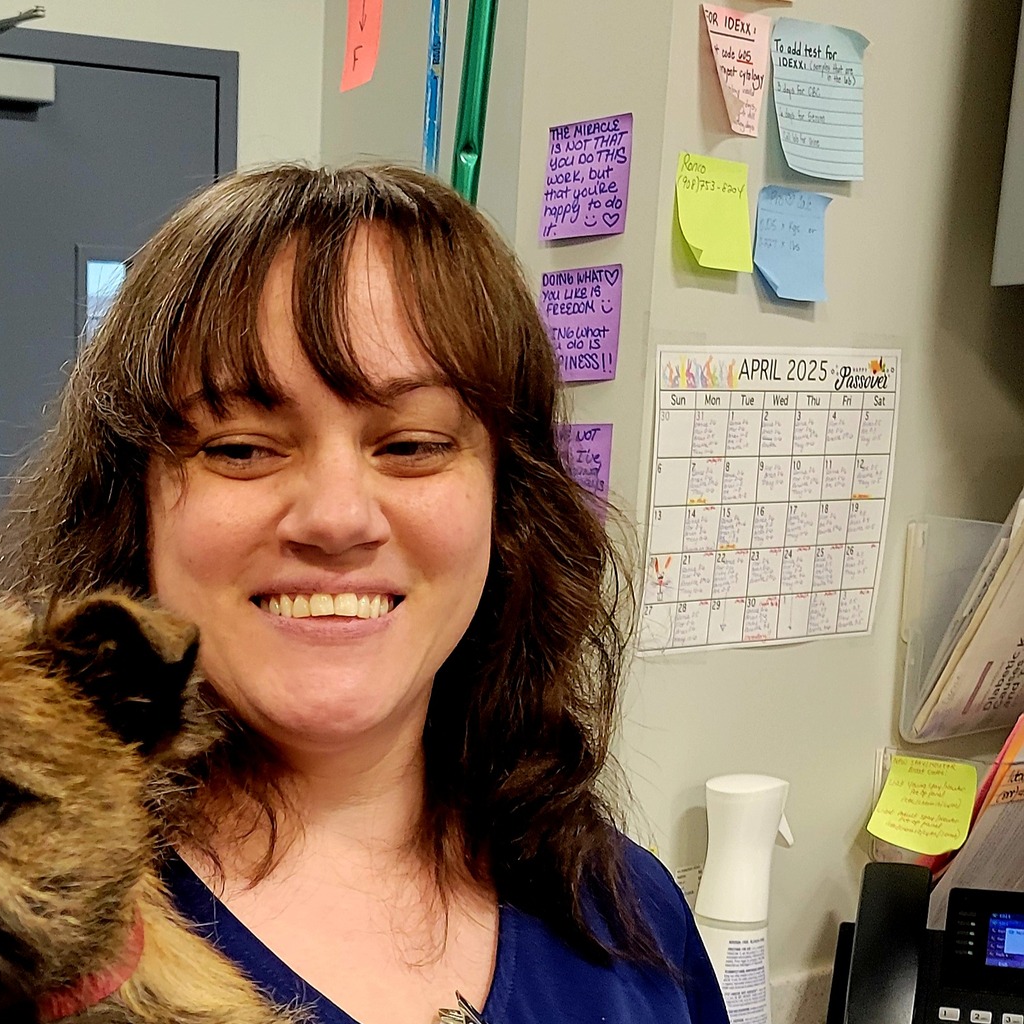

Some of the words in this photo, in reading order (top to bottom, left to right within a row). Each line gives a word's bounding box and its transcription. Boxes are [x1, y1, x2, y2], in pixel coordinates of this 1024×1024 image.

[774, 39, 784, 53] To
[787, 41, 802, 56] add
[804, 44, 822, 59] test
[825, 45, 838, 60] for
[550, 127, 571, 140] THE
[574, 119, 620, 138] MIRACLE
[551, 143, 561, 155] IS
[565, 138, 593, 152] NOT
[594, 131, 629, 150] THAT
[578, 153, 594, 165] DO
[596, 146, 628, 164] THIS
[589, 165, 614, 180] but
[544, 187, 571, 201] that
[544, 202, 581, 223] happy
[588, 198, 602, 212] to
[605, 195, 623, 210] do
[542, 272, 574, 287] DOING
[577, 269, 604, 285] WHAT
[590, 285, 601, 298] IS
[546, 300, 596, 316] FREEDOM
[567, 339, 584, 349] do
[738, 358, 781, 381] APRIL
[787, 359, 829, 381] 2025
[834, 366, 889, 391] Passover
[671, 394, 686, 406] Sun
[705, 394, 721, 406] Mon
[741, 395, 755, 406] Tue
[773, 395, 789, 406] Wed
[807, 395, 821, 406] Thu
[842, 395, 852, 406] Fri
[874, 395, 886, 406] Sat
[696, 411, 704, 421] 31
[793, 460, 801, 470] 10
[826, 459, 832, 469] 11
[857, 459, 865, 469] 12
[655, 510, 662, 521] 13
[688, 509, 696, 518] 14
[723, 507, 731, 517] 15
[757, 506, 765, 516] 16
[790, 505, 798, 515] 17
[821, 504, 829, 514] 18
[852, 502, 859, 512] 19
[683, 555, 691, 565] 21
[717, 553, 726, 563] 22
[751, 551, 760, 561] 23
[784, 550, 793, 559] 24
[817, 548, 825, 557] 25
[846, 546, 854, 556] 26
[644, 606, 653, 616] 27
[678, 603, 687, 613] 28
[712, 600, 721, 610] 29
[747, 598, 756, 608] 30
[982, 651, 1020, 711] Diabetic
